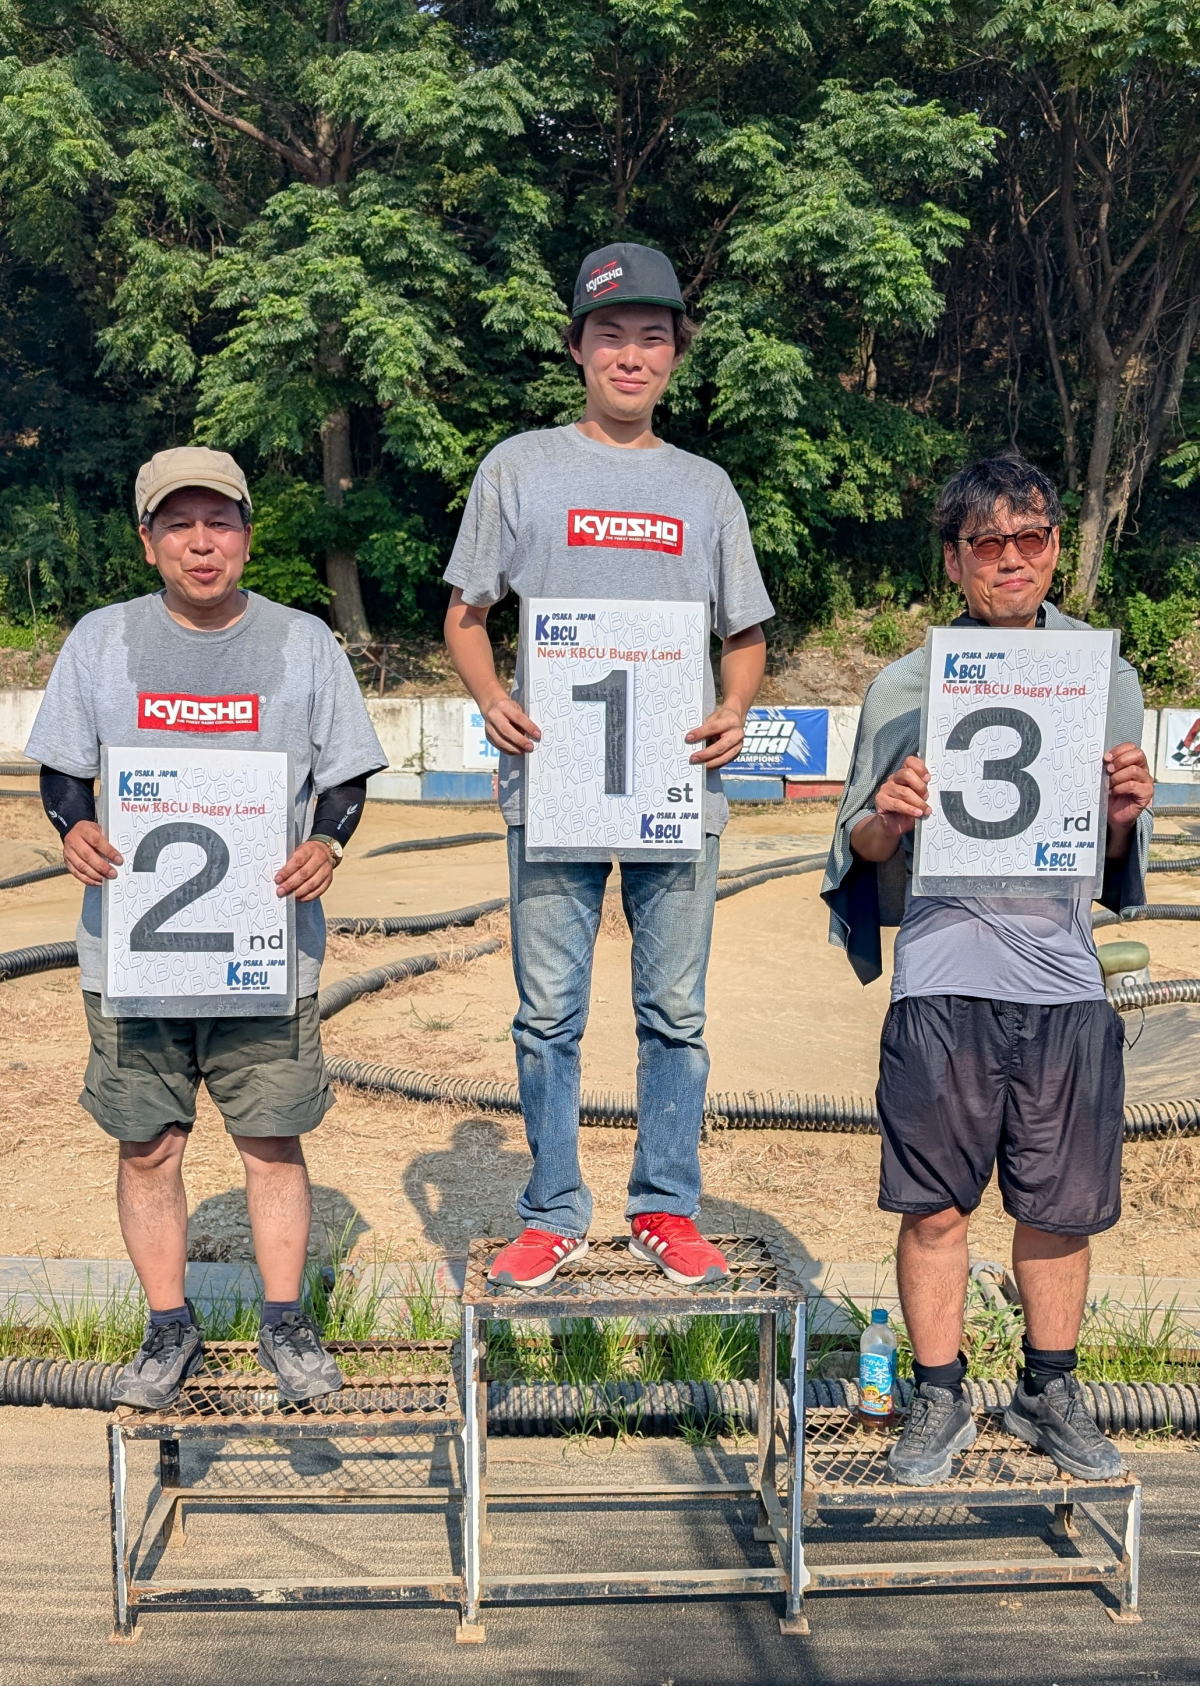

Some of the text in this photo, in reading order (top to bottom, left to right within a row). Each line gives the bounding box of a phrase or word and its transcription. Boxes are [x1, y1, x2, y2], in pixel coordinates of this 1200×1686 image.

[574, 515, 678, 542] KYOSHO
[535, 614, 578, 641] KBCU
[551, 612, 596, 621] OSAKA JAPAN
[537, 647, 681, 662] New KBCU Buggy Land
[943, 653, 986, 680] KBCU
[961, 651, 1005, 660] OSAKA JAPAN
[942, 683, 1086, 698] New KBCU Buggy Land
[144, 699, 253, 725] KYOSHO
[572, 669, 693, 803] 1 st
[119, 771, 160, 797] KBCU
[134, 769, 154, 777] OSAKA
[939, 706, 1090, 840] 3 rd
[121, 802, 266, 816] New KBCU Buggy Land
[656, 811, 699, 820] OSAKA JAPAN
[640, 813, 681, 839] KBCU
[1034, 842, 1076, 867] KBCU
[1075, 841, 1095, 849] JAPAN
[130, 821, 284, 953] 2 nd
[226, 961, 268, 986] KBCU
